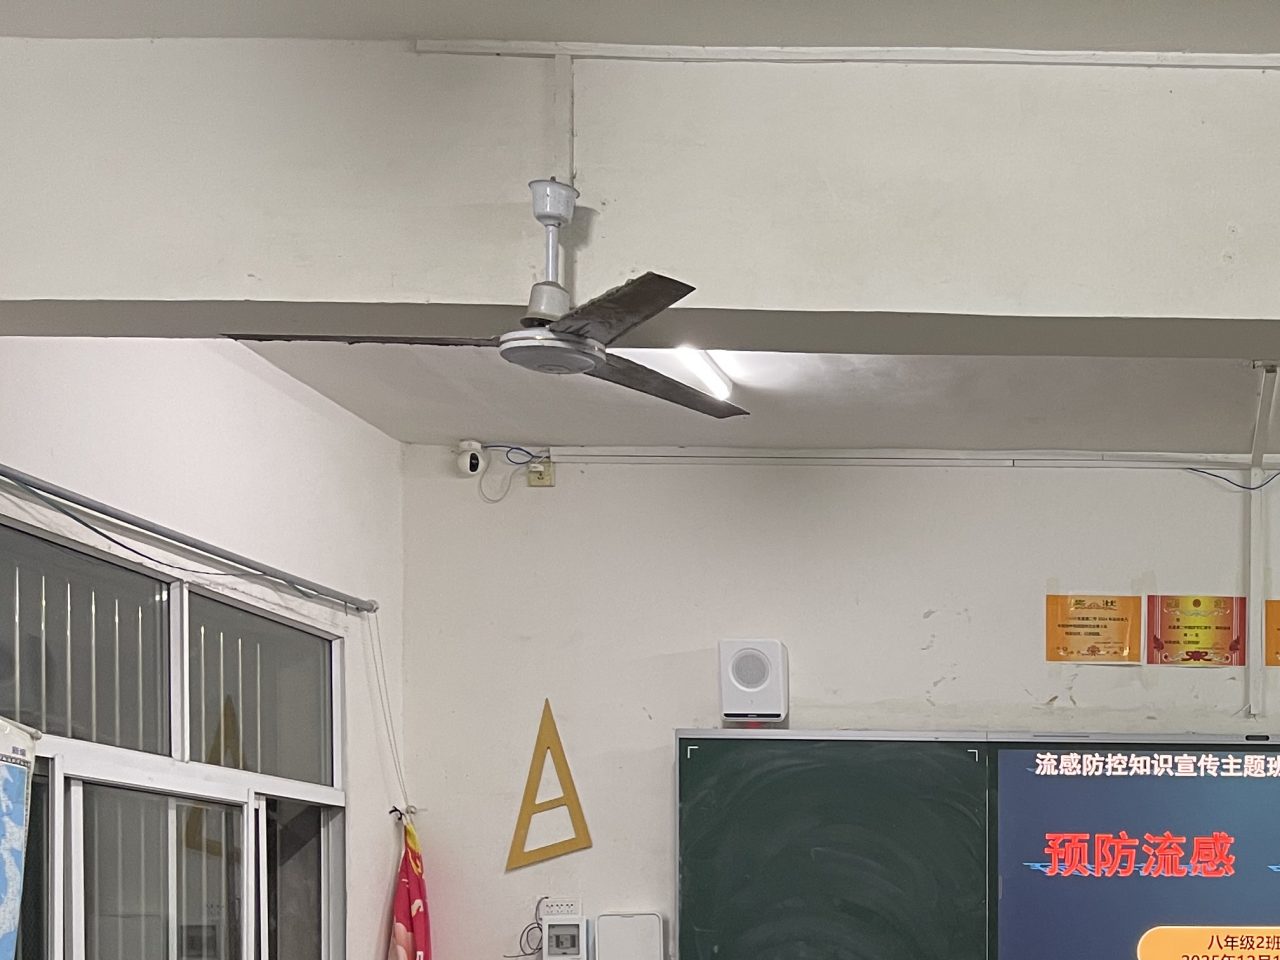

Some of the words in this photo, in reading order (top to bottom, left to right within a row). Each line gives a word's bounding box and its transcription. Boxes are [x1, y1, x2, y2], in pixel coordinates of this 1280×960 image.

[1044, 831, 1236, 878] 预防流感
[1207, 935, 1280, 950] 八年级2班
